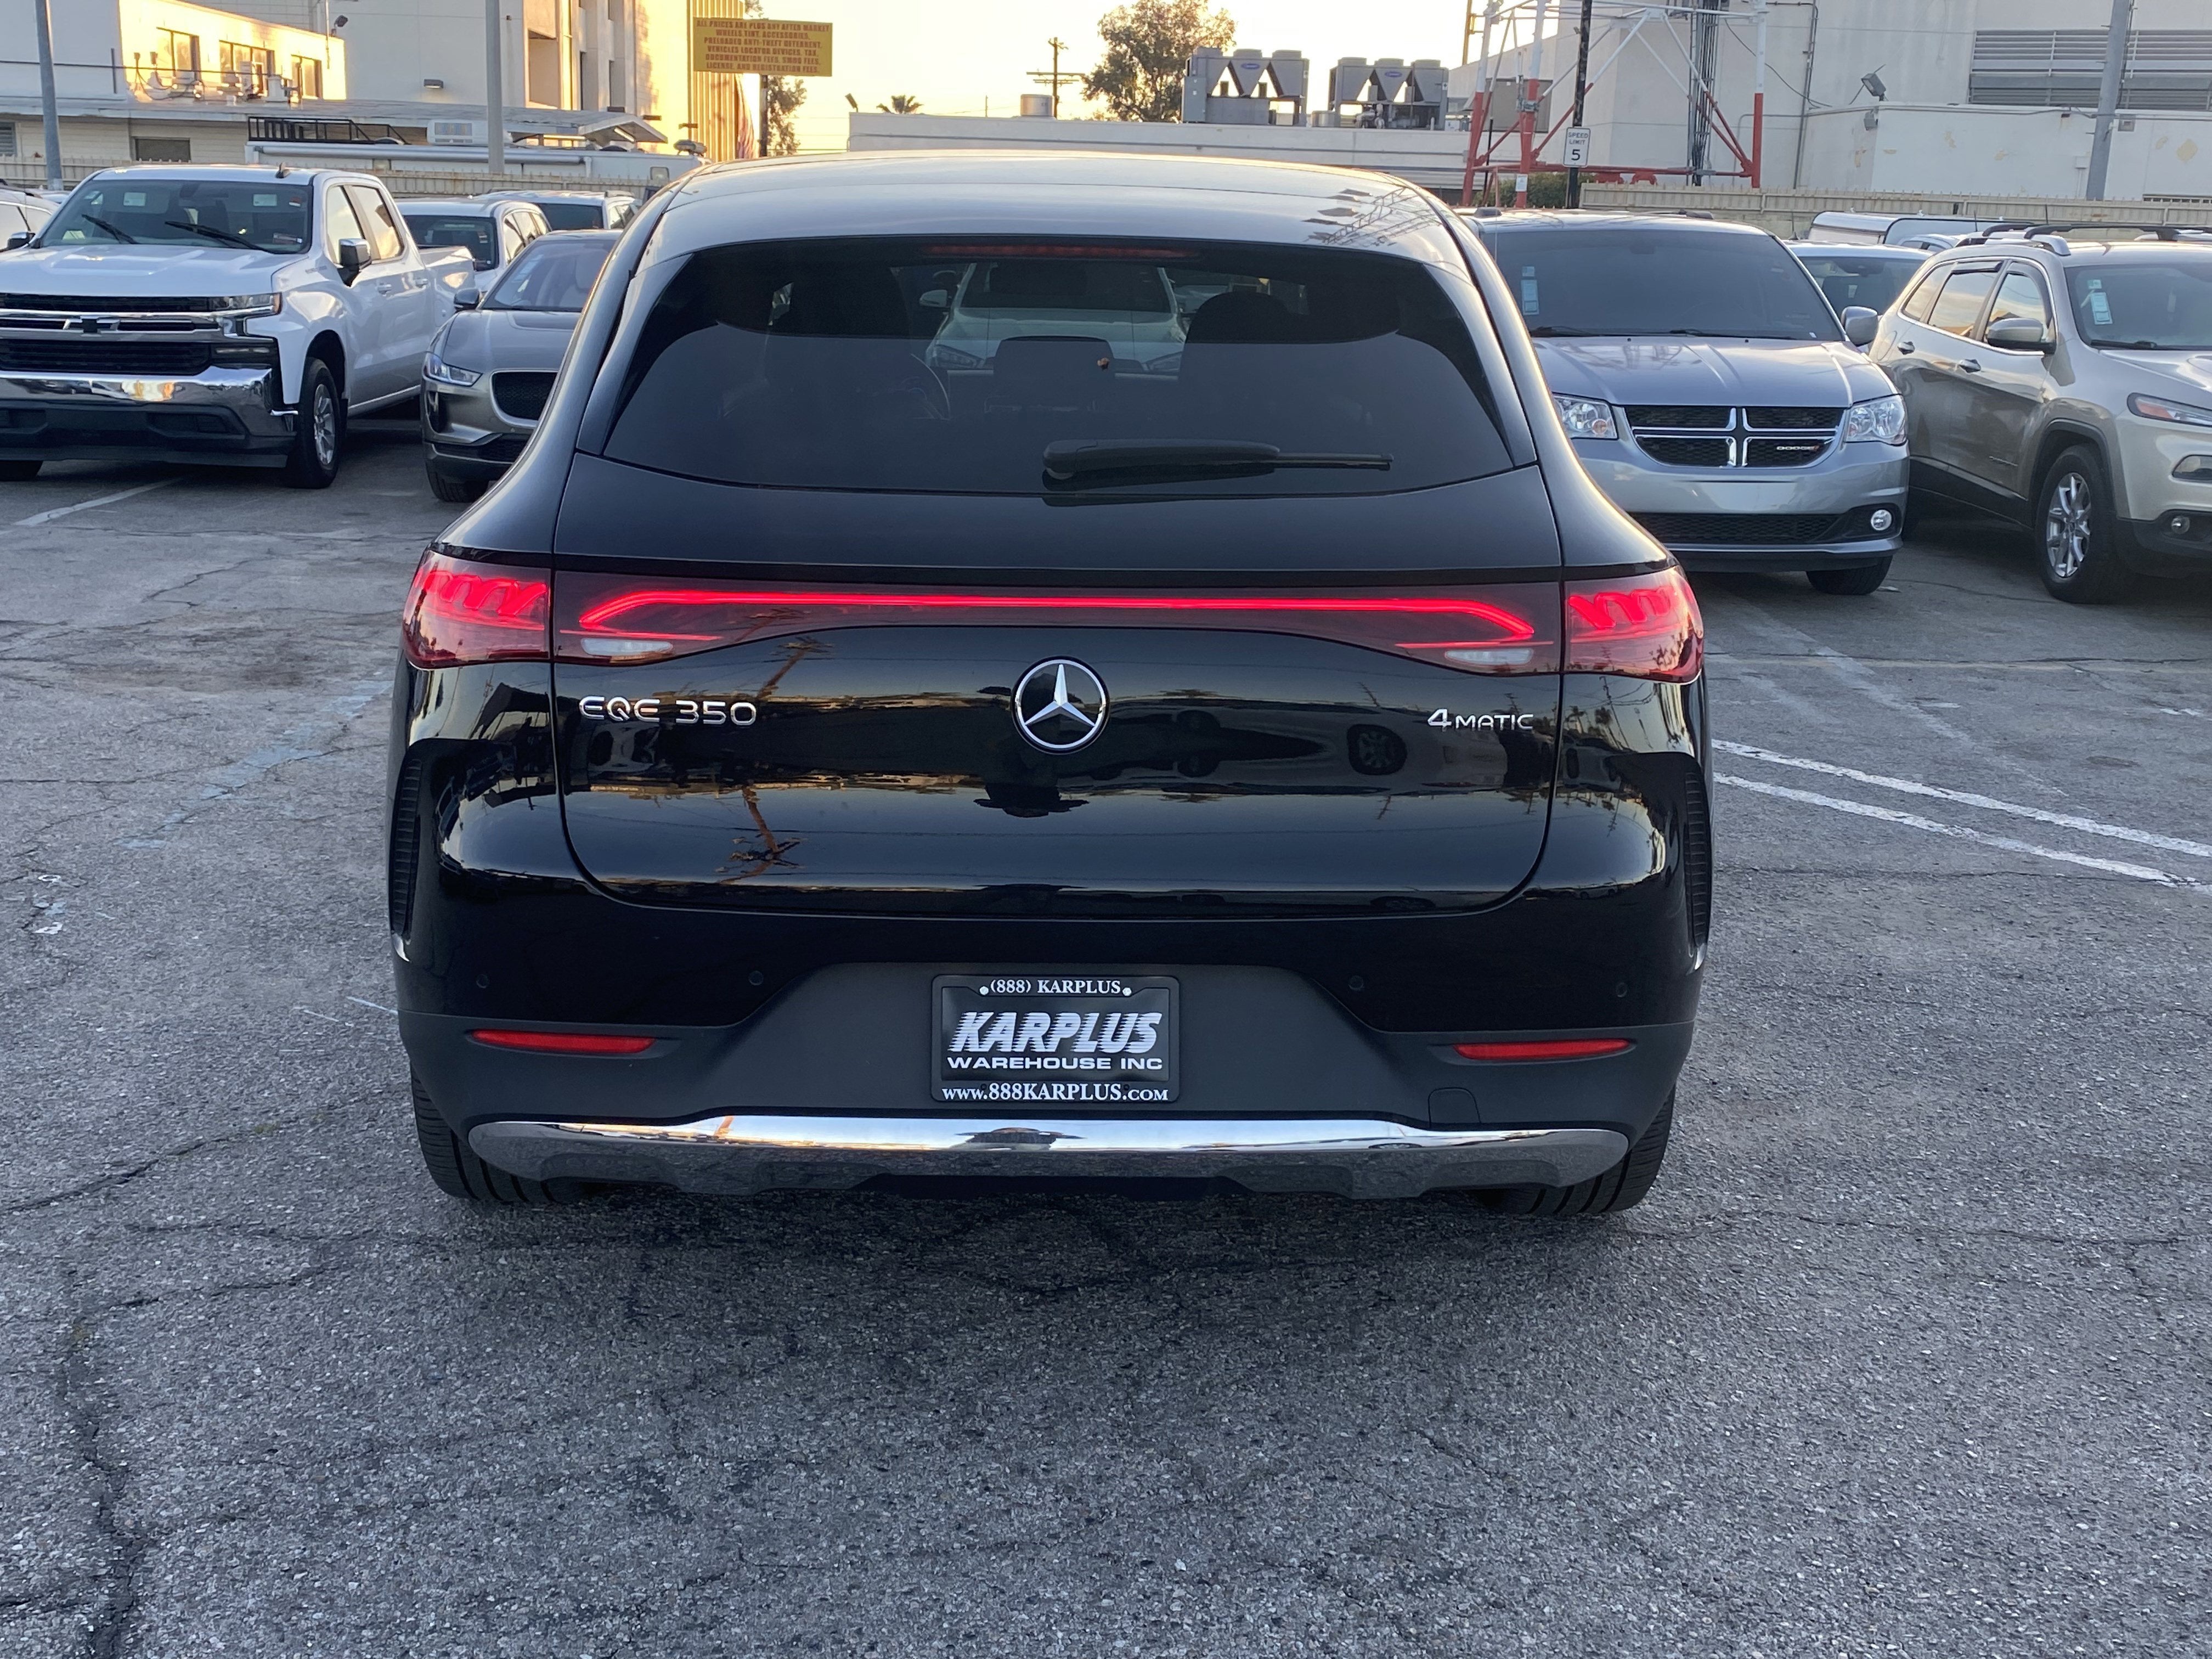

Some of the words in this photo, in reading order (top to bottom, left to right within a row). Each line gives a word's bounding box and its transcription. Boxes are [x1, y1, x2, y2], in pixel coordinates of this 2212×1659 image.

[1571, 149, 1581, 161] 5
[579, 696, 660, 722] EQE
[675, 699, 757, 726] 350
[990, 979, 1031, 994] (888)
[1037, 979, 1121, 994] KARPLUS
[947, 1011, 1163, 1054] KARPLUS
[947, 1057, 1111, 1070] WAREHOUSE
[1120, 1058, 1163, 1070] INC
